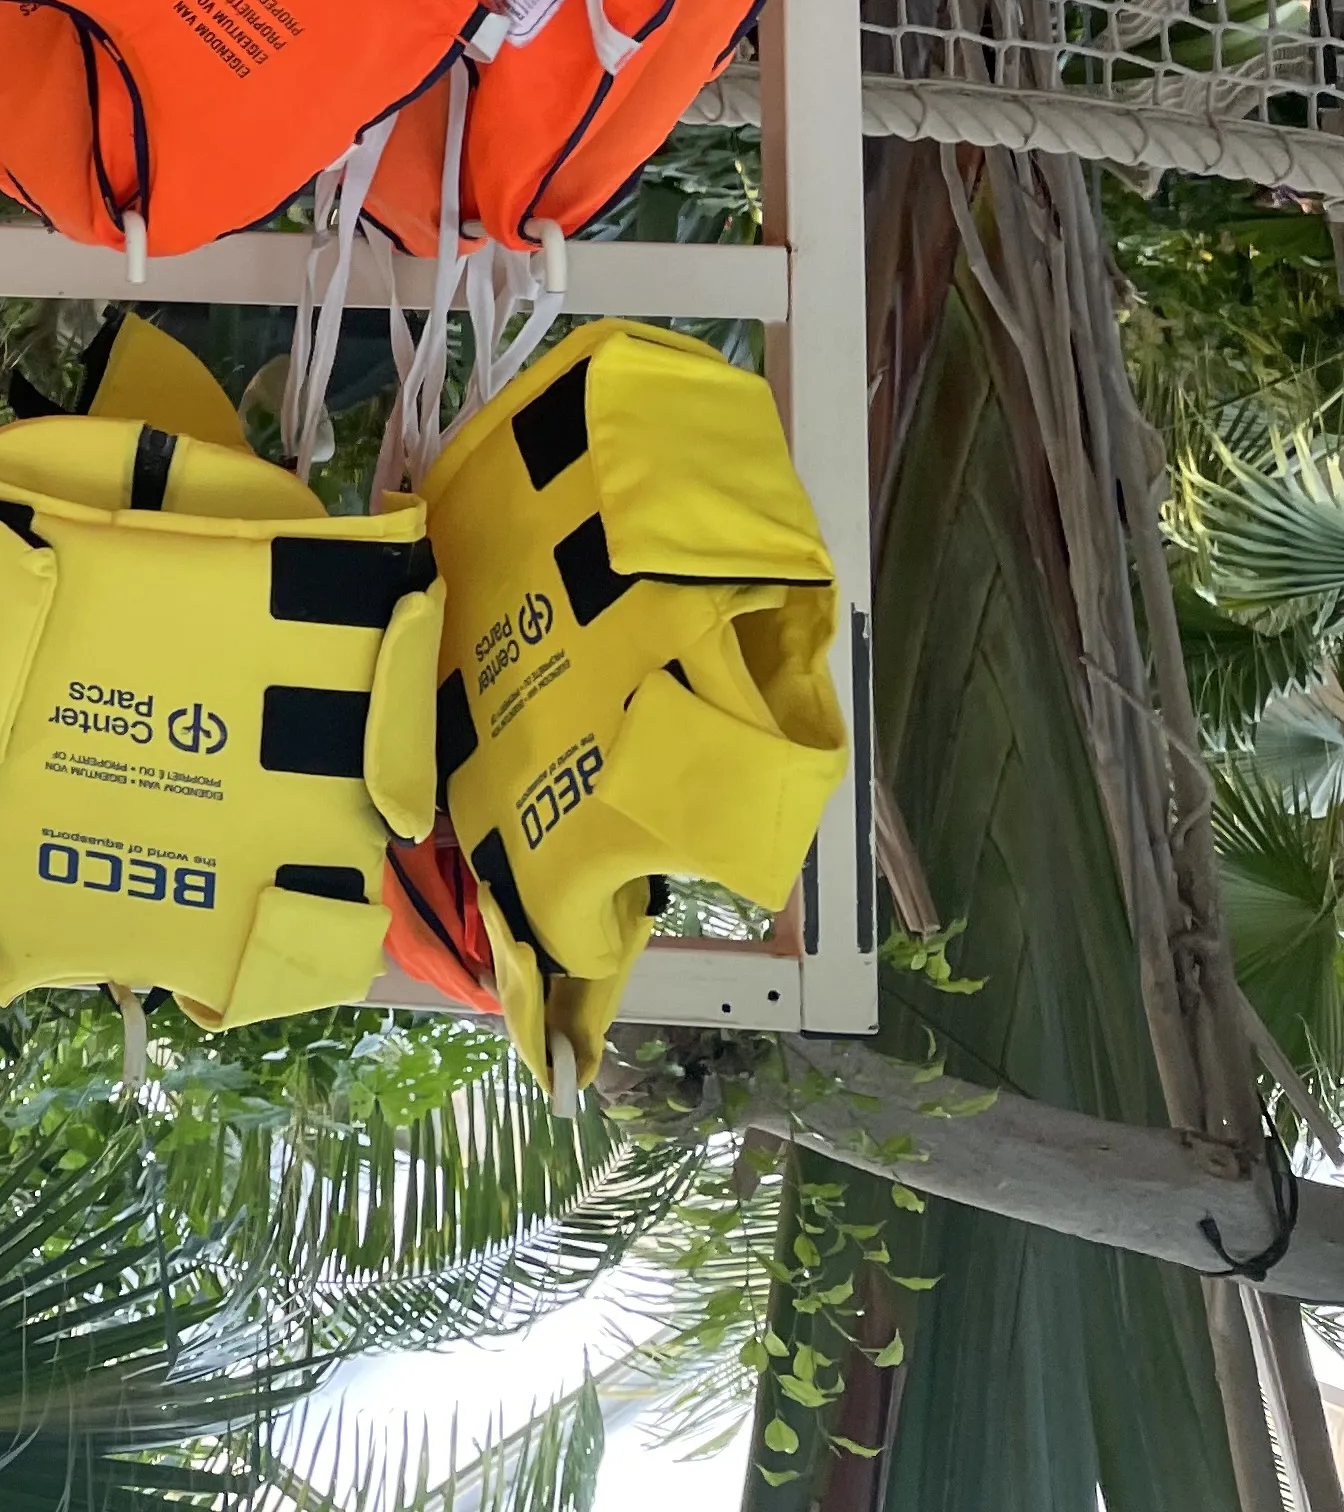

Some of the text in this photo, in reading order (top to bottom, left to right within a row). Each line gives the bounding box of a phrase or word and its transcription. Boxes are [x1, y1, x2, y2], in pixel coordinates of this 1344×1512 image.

[173, 0, 251, 78] EIGENDOM VAN
[212, 10, 269, 65] EIGENTUM
[474, 613, 513, 663] Parcs
[476, 639, 520, 696] Center
[68, 681, 153, 718] Parcs
[48, 706, 153, 744] Center
[45, 761, 68, 774] VON
[51, 750, 66, 761] OF
[68, 754, 127, 772] PROPERTY
[71, 767, 127, 784] EIGENTUM
[138, 778, 160, 790] VAN
[521, 745, 603, 851] BECO
[41, 828, 216, 868] the world of aquasports
[38, 842, 216, 910] BECO
